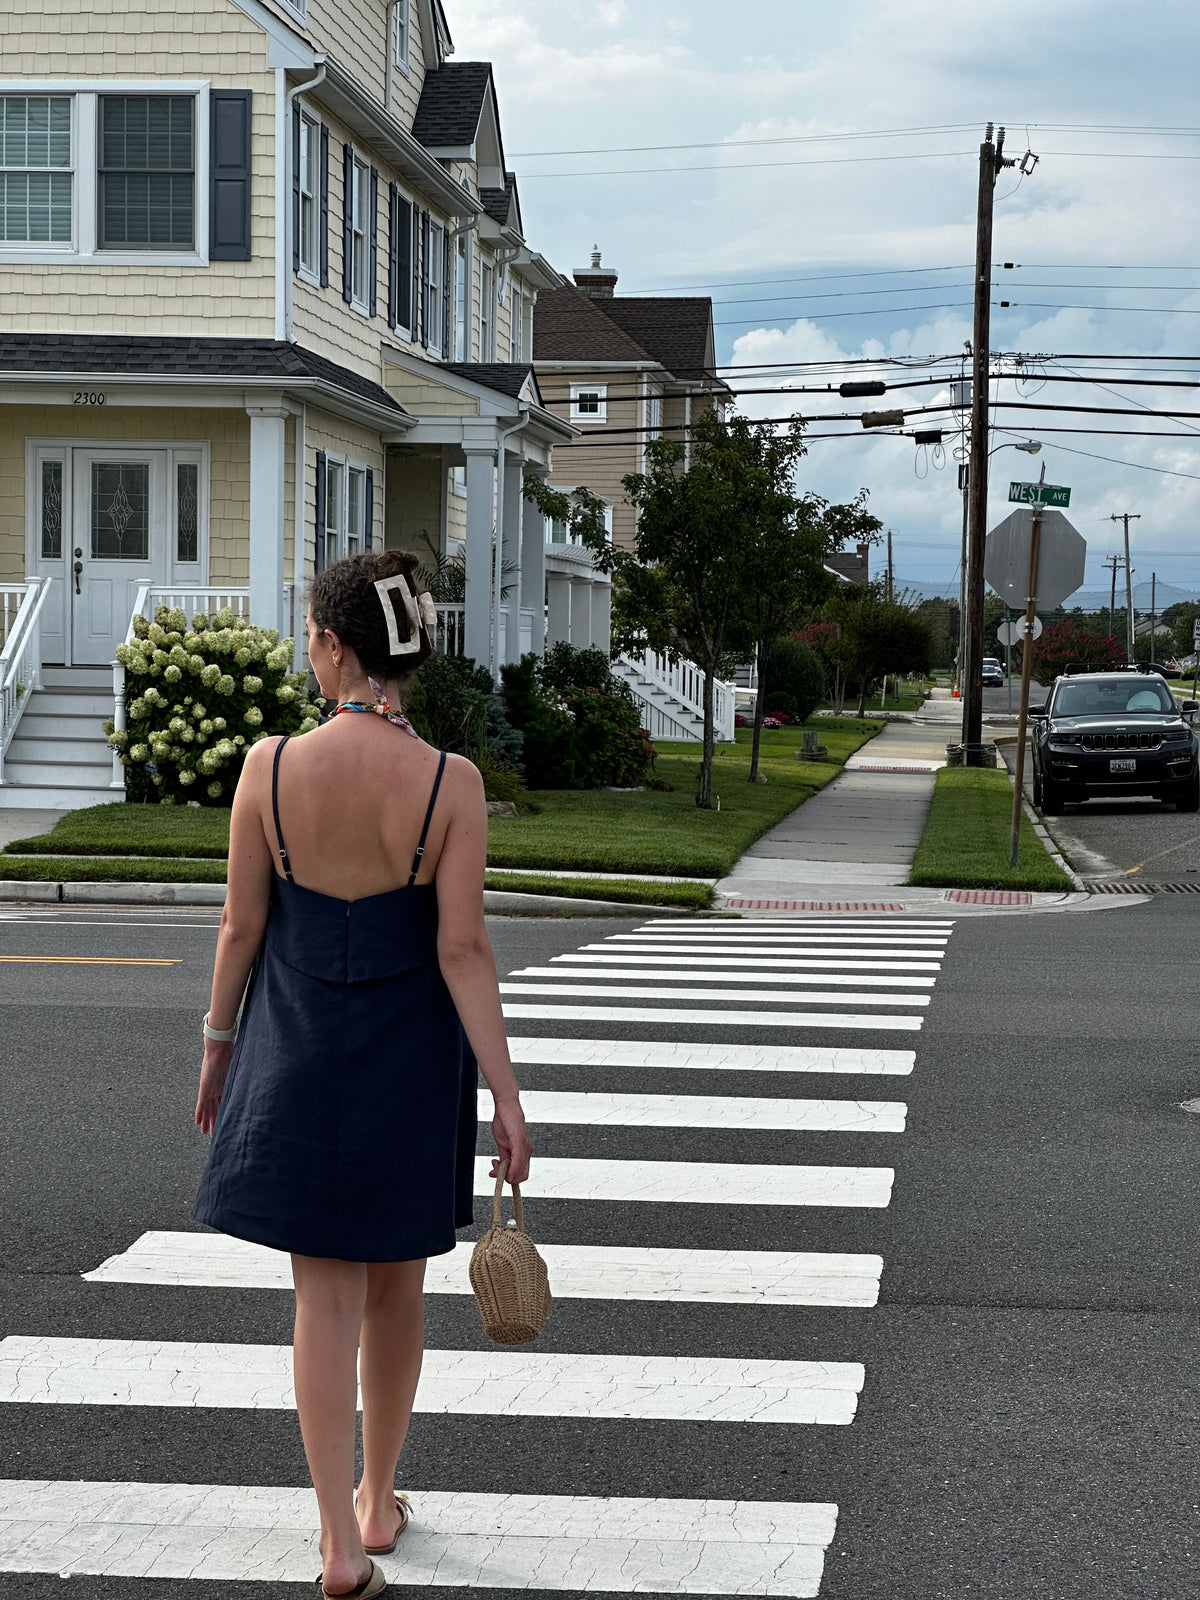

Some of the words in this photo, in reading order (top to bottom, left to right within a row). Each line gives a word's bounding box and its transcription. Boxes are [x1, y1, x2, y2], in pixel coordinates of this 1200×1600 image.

[73, 392, 105, 405] 2300
[1010, 484, 1043, 502] WEST
[1052, 492, 1068, 501] AVE
